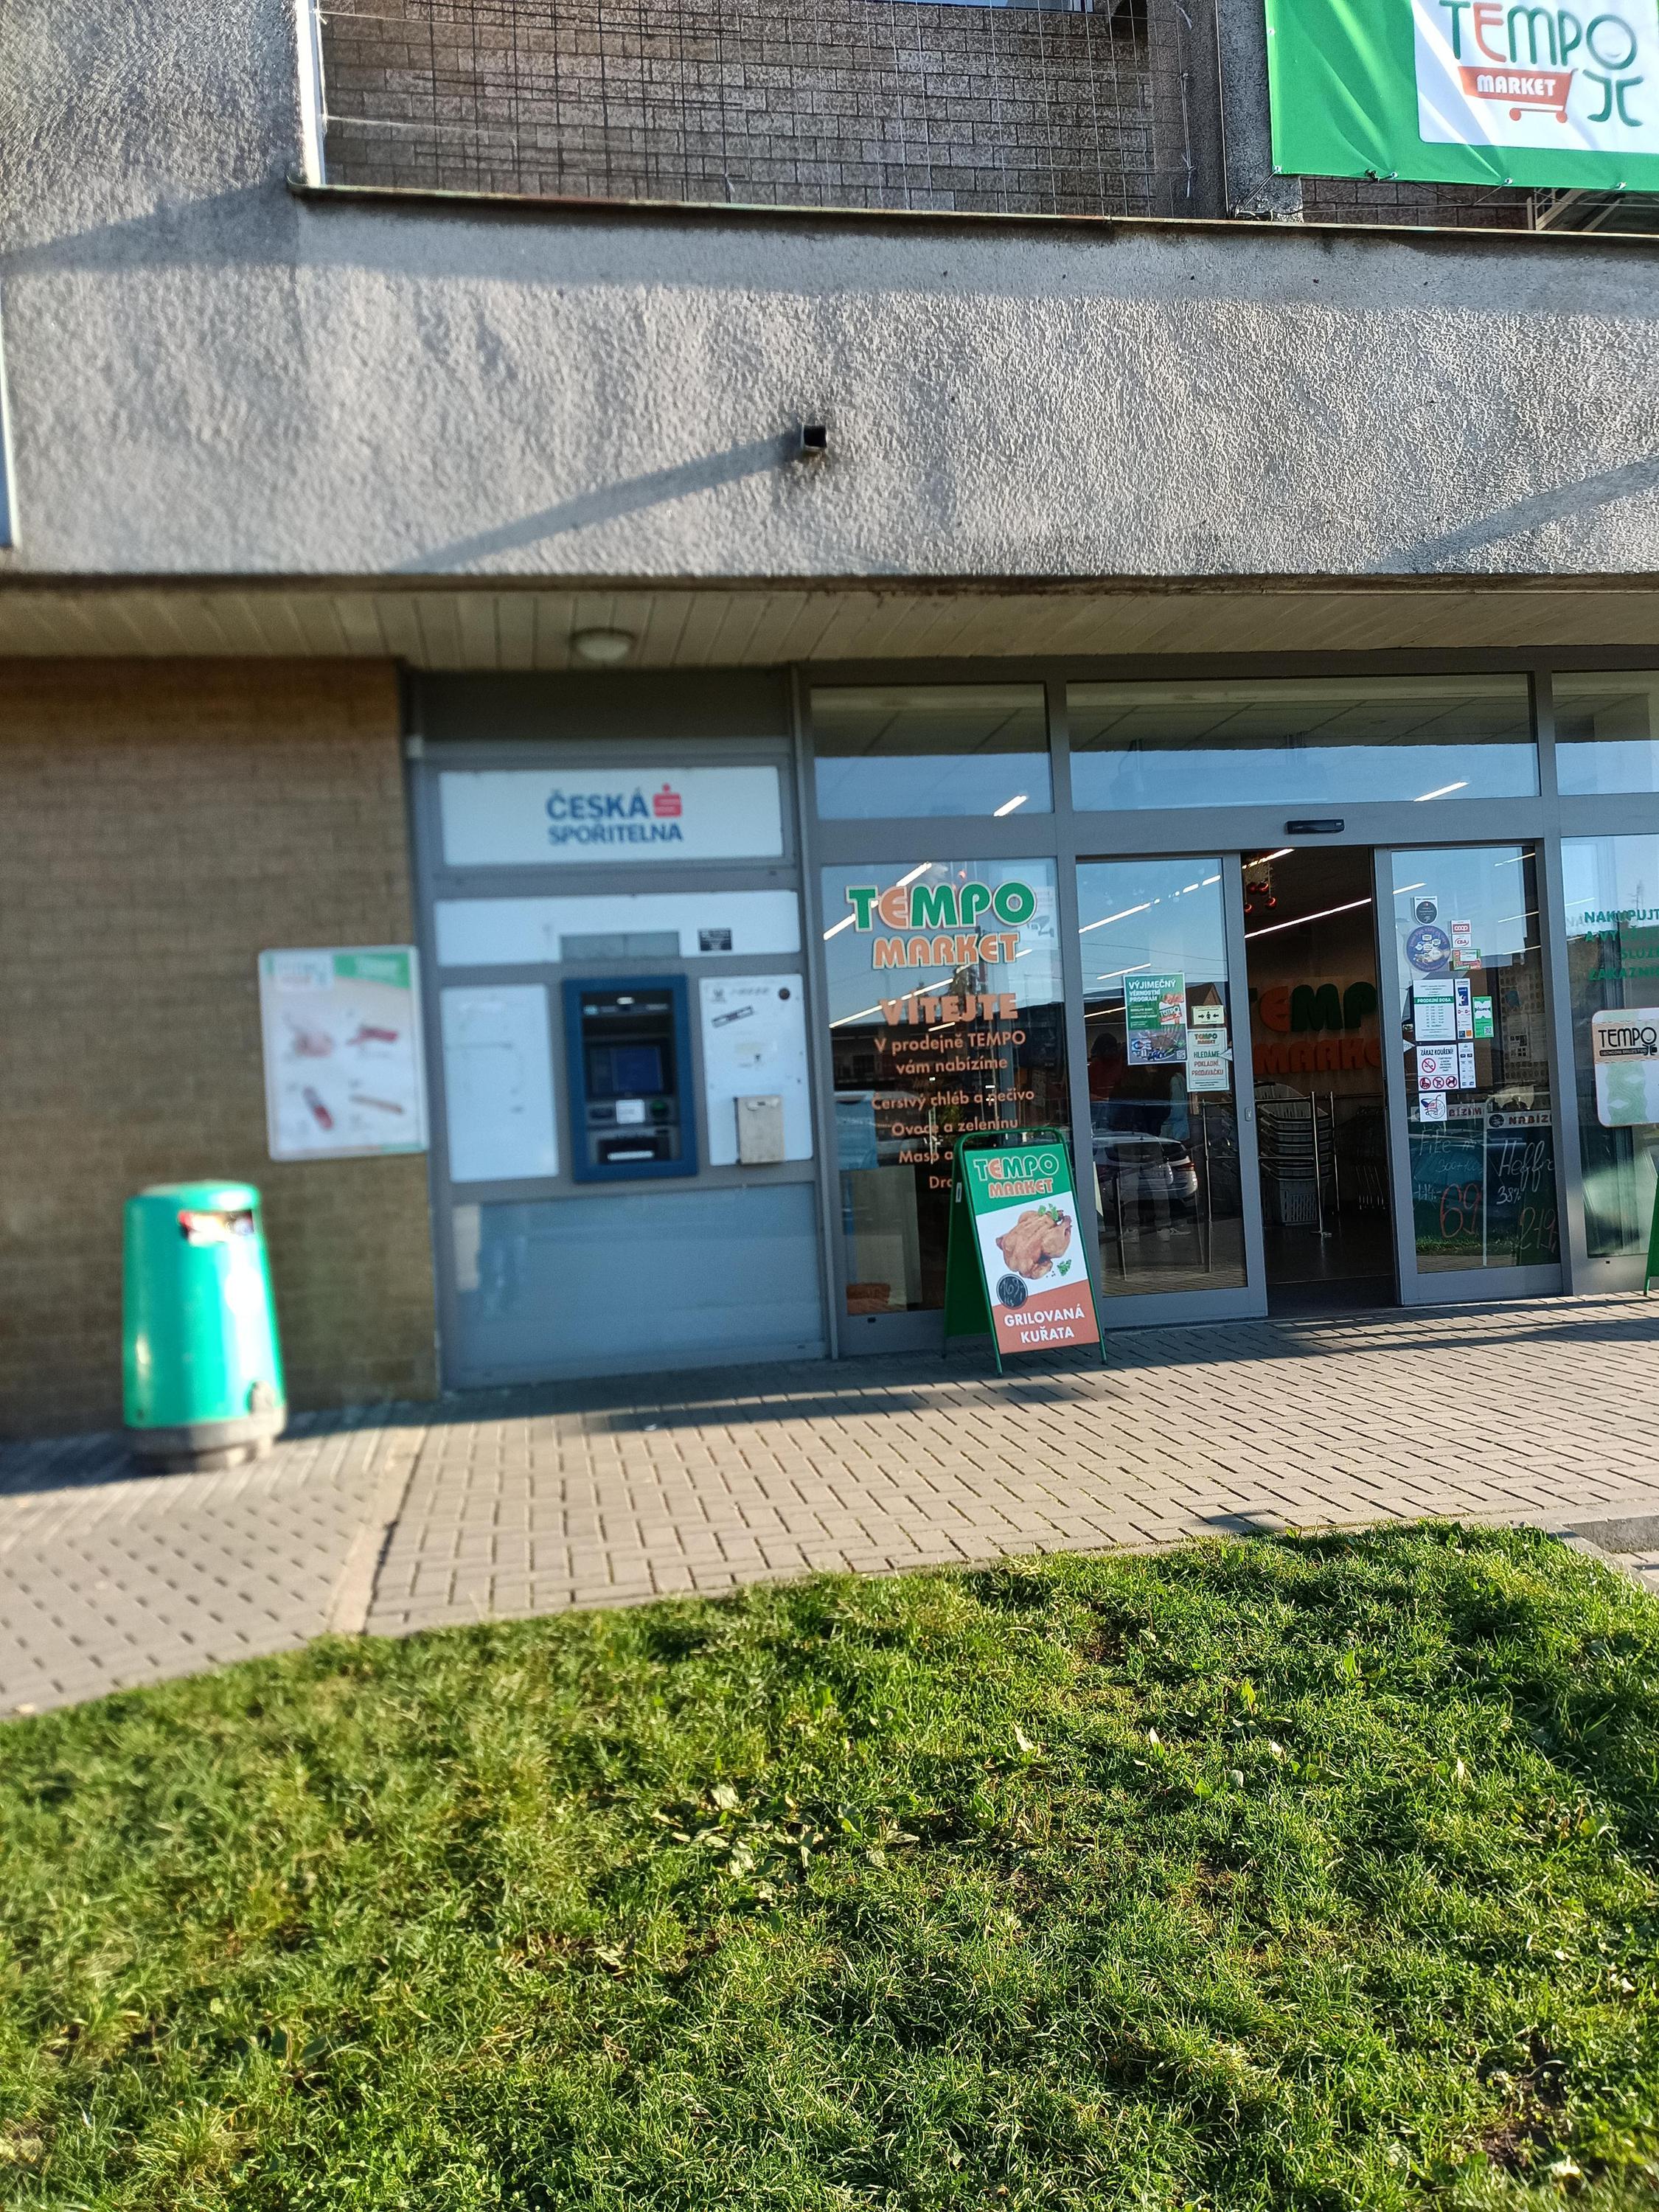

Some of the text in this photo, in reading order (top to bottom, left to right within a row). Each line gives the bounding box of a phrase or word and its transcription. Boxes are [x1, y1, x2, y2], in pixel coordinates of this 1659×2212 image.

[1439, 0, 1638, 70] TEMPO
[1476, 74, 1555, 97] MARKET
[546, 787, 650, 820] ČESKÁ
[548, 823, 684, 846] SPOŘITELNA
[845, 880, 1037, 932] TEMPO
[873, 931, 1019, 969] MARKET
[1129, 978, 1176, 990] VÝJIMEČNÝ
[879, 990, 1018, 1026] VÍTEJTE
[1248, 981, 1377, 1032] EMP
[874, 1030, 1026, 1057] V prodejně TEMPO
[1598, 1027, 1657, 1048] TEMPO
[1194, 1050, 1220, 1058] HLEDÁME
[1420, 1048, 1433, 1056] ZÁKAZ
[896, 1055, 1008, 1074] vám nabízíme
[872, 1088, 1035, 1111] Čerstvý chléb a pečivo
[891, 1116, 1018, 1136] Ovoce a zeleninu
[899, 1150, 953, 1164] Maso a
[973, 1153, 1059, 1181] TEMPO
[988, 1178, 1054, 1198] MARKET
[1004, 1304, 1085, 1326] GRILOVANÁ
[1020, 1325, 1074, 1343] KUŘATA
